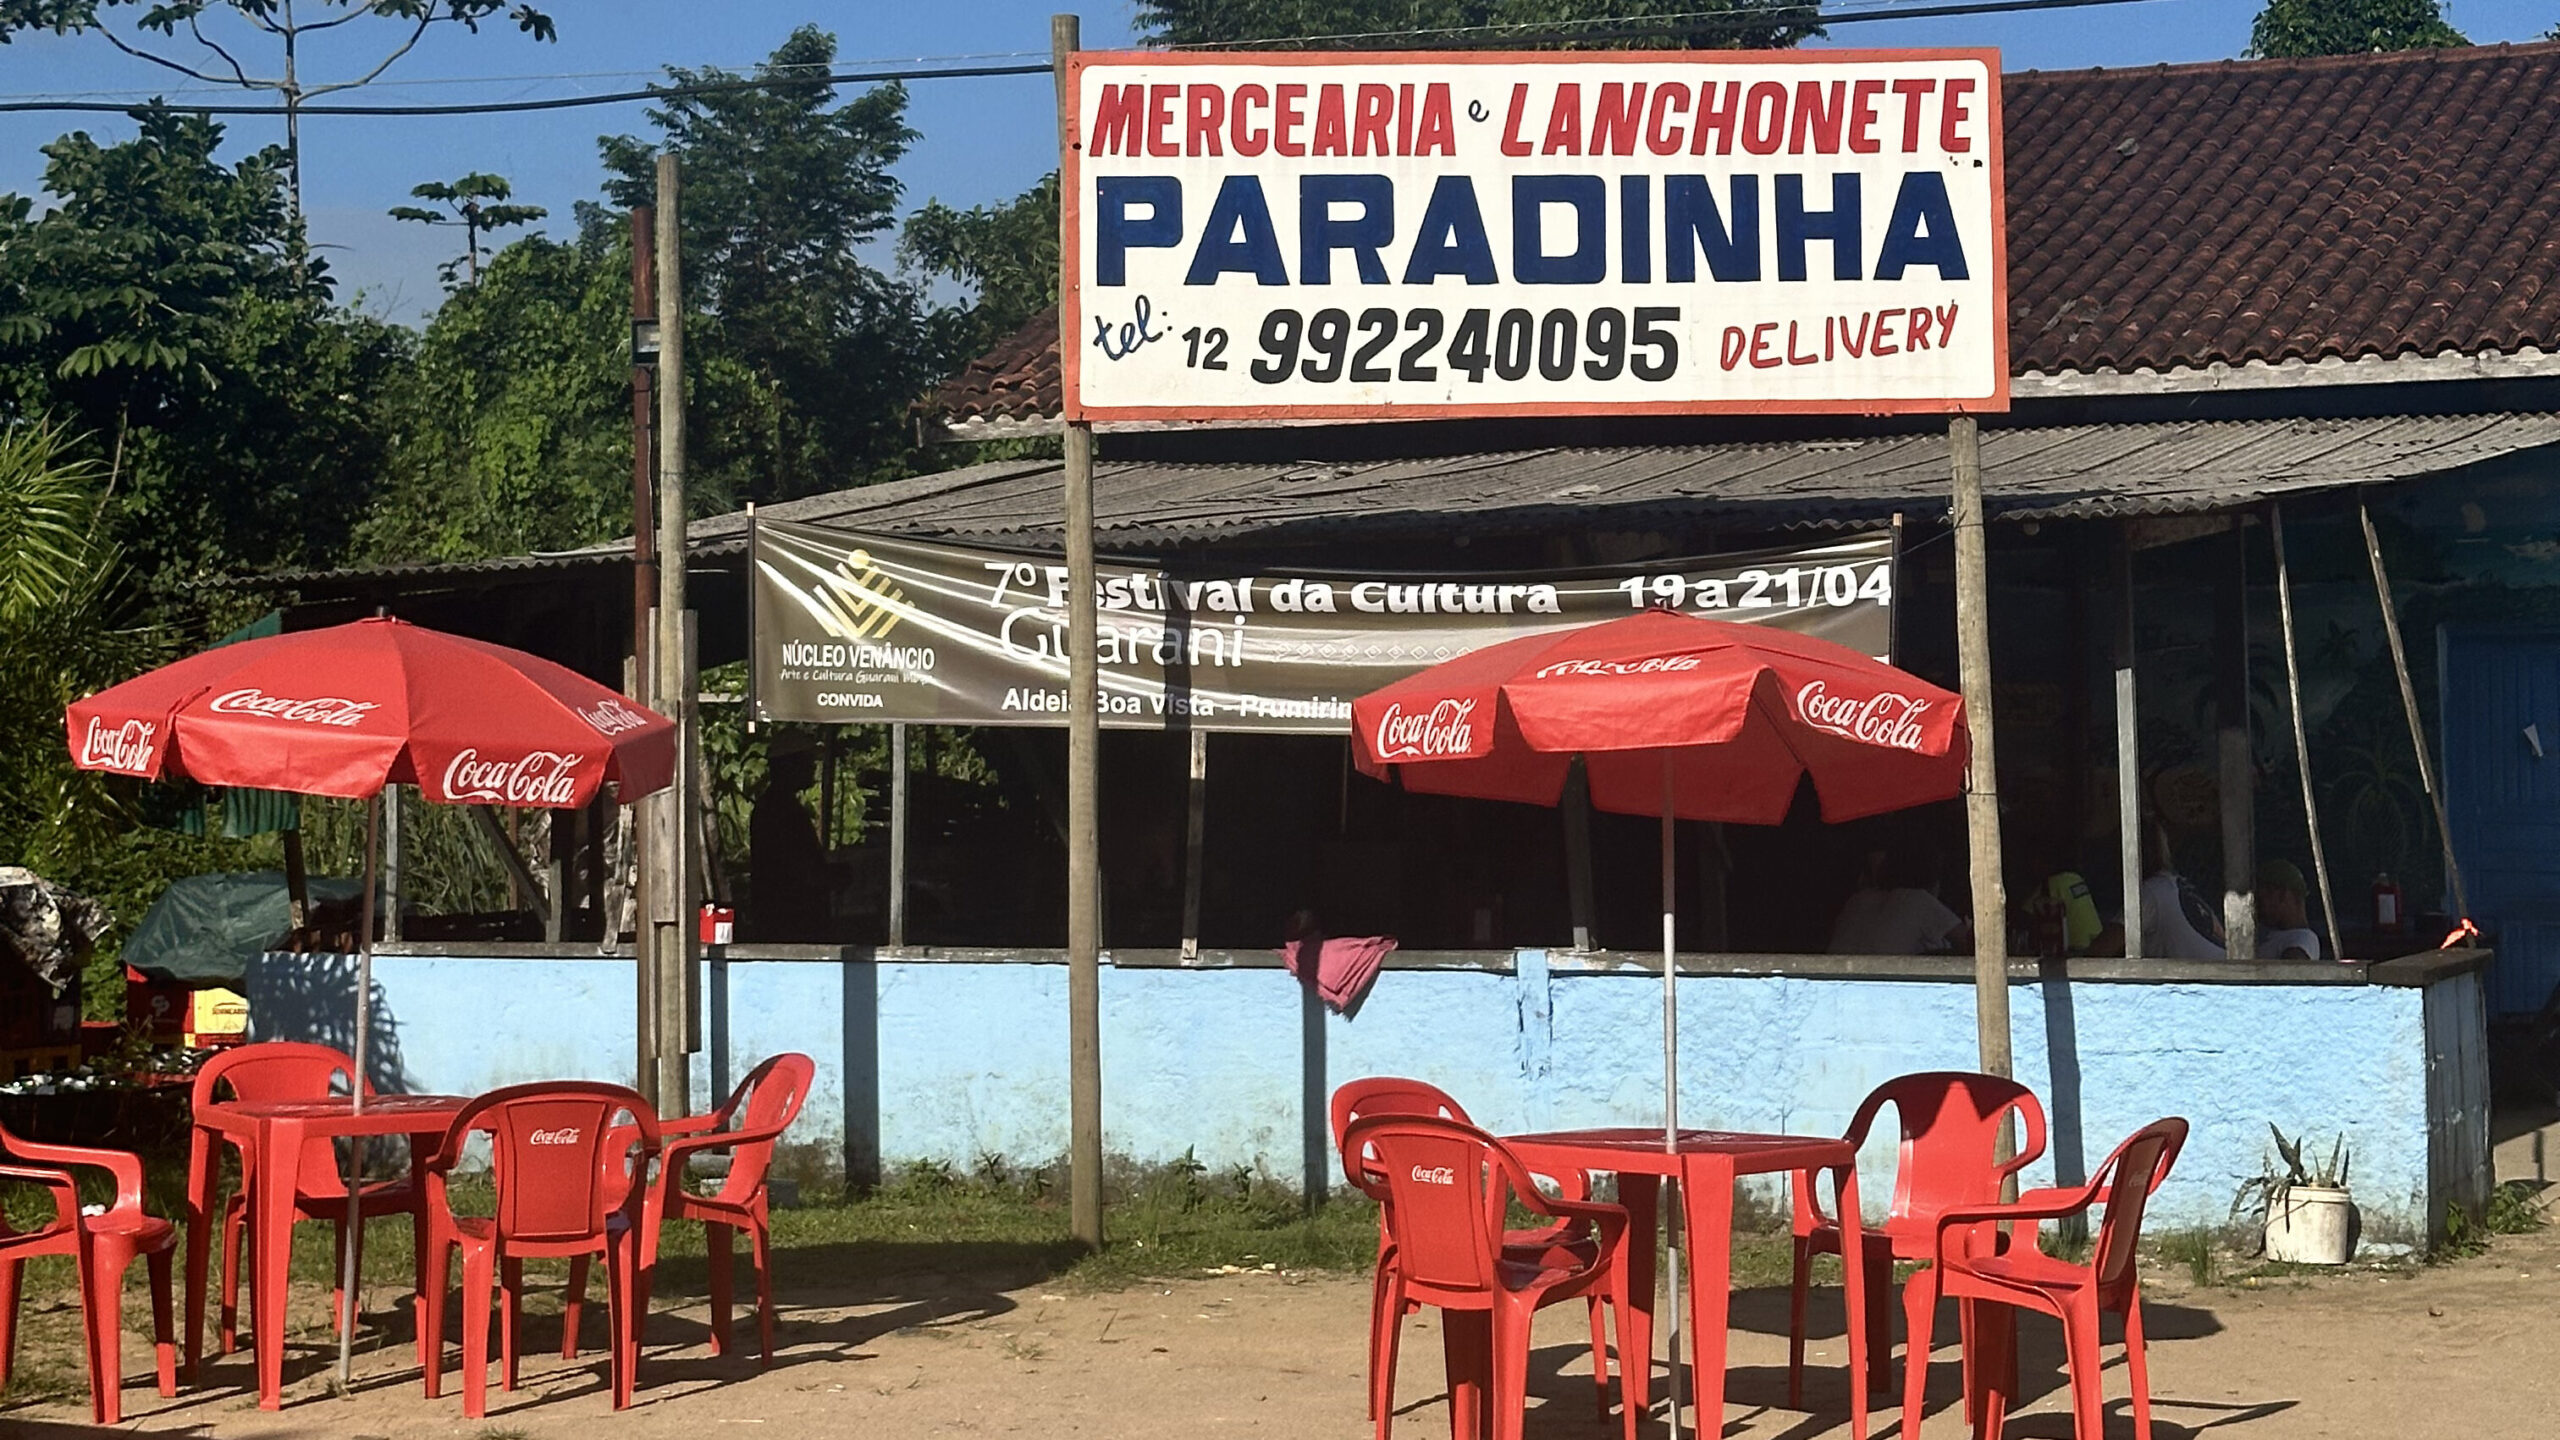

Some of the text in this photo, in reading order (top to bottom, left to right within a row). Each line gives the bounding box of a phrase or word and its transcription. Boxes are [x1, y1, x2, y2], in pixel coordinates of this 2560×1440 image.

[1089, 78, 1976, 157] MERCEARIA e LANCHONETE
[1096, 171, 1971, 286] PARADINHA
[1093, 295, 1959, 384] tel: 12 992240095 DELIVERY
[1270, 579, 1337, 613] da
[1350, 581, 1562, 613] Cultura
[1619, 564, 1892, 608] 19 a 21/04
[782, 639, 936, 670] NÚCLEO VENÂNCIO
[780, 669, 802, 681] Arte
[803, 671, 810, 681] e
[813, 669, 853, 682] Cultura
[855, 671, 900, 684] Guarani
[210, 689, 381, 727] Coca-Cola
[817, 693, 884, 708] CONVIDA
[1001, 688, 1071, 713] Aldei
[1097, 690, 1142, 715] Boa
[1150, 692, 1214, 716] Vista
[1796, 680, 1932, 750] Coca-Cola
[82, 716, 155, 772] Coca-Cola
[1377, 698, 1477, 758] Coca-Cola
[443, 748, 584, 803] Coca-Cola
[530, 1127, 580, 1145] Coca-Cola
[1411, 1165, 1454, 1185] Coca-Cola
